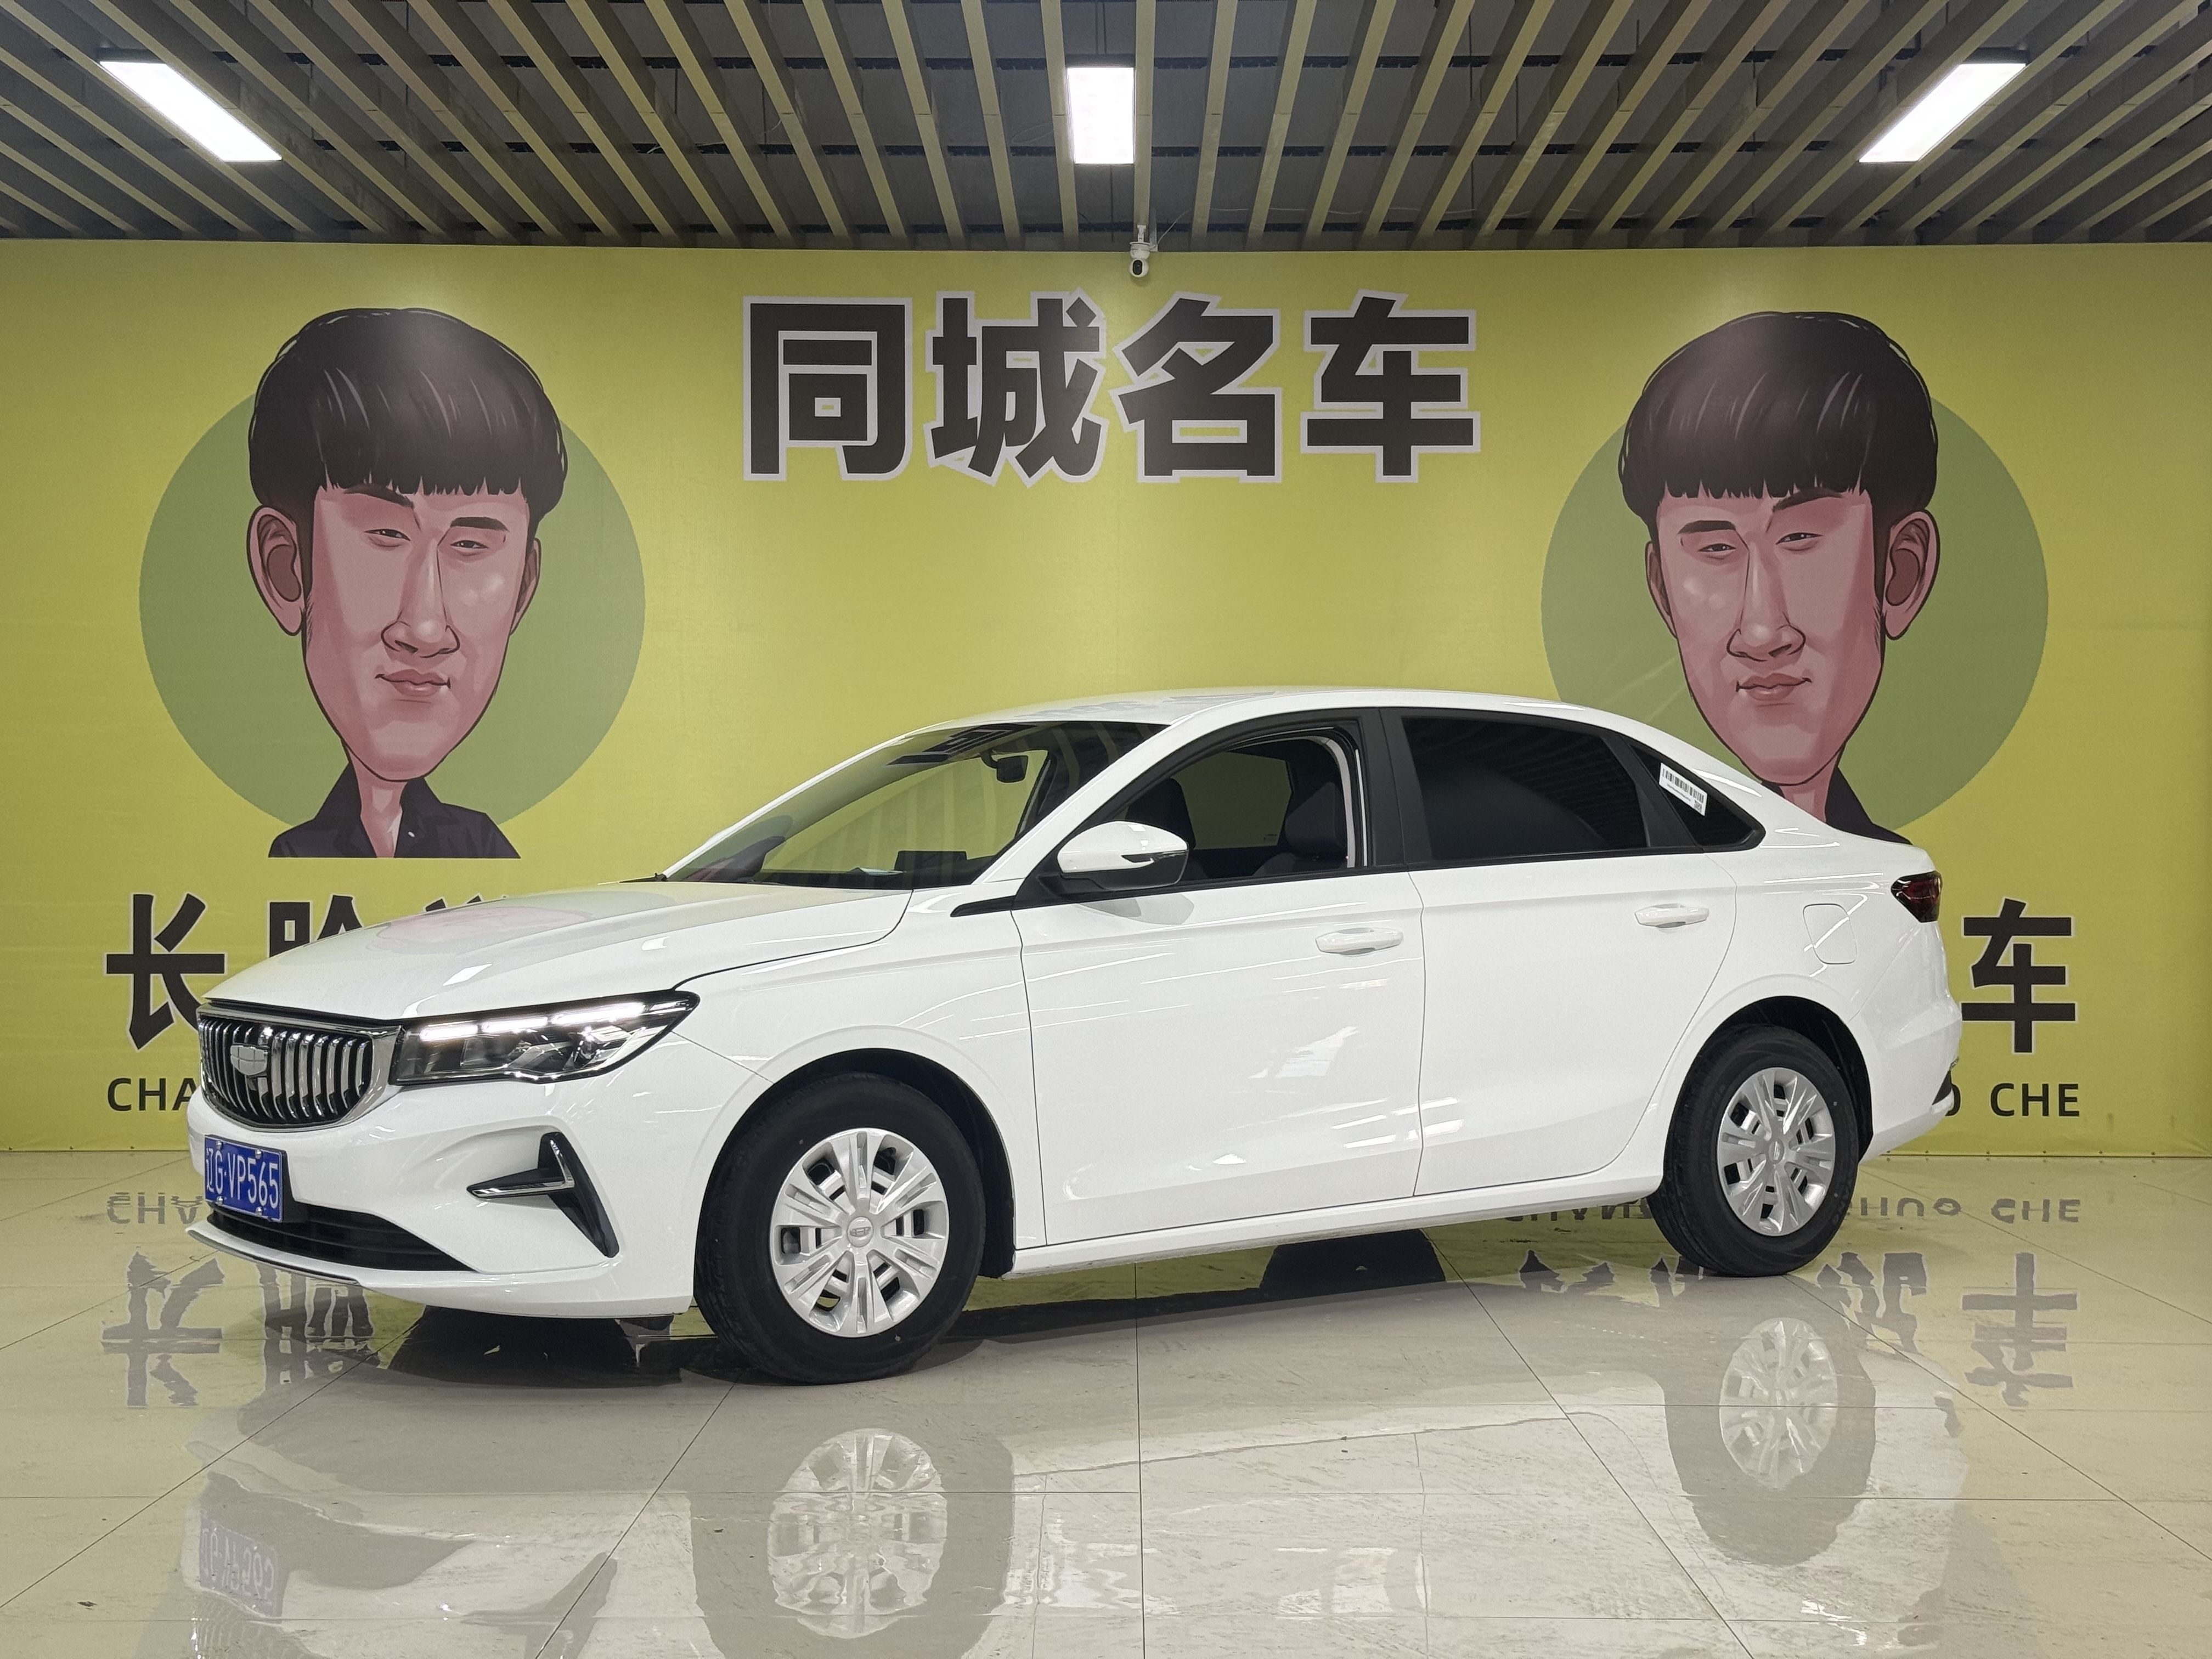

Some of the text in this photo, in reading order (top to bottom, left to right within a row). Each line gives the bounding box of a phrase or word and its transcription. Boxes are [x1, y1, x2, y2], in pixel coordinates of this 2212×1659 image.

[747, 293, 1477, 483] 同城名车
[1961, 898, 2076, 1053] 车
[1990, 1082, 2080, 1116] CHE
